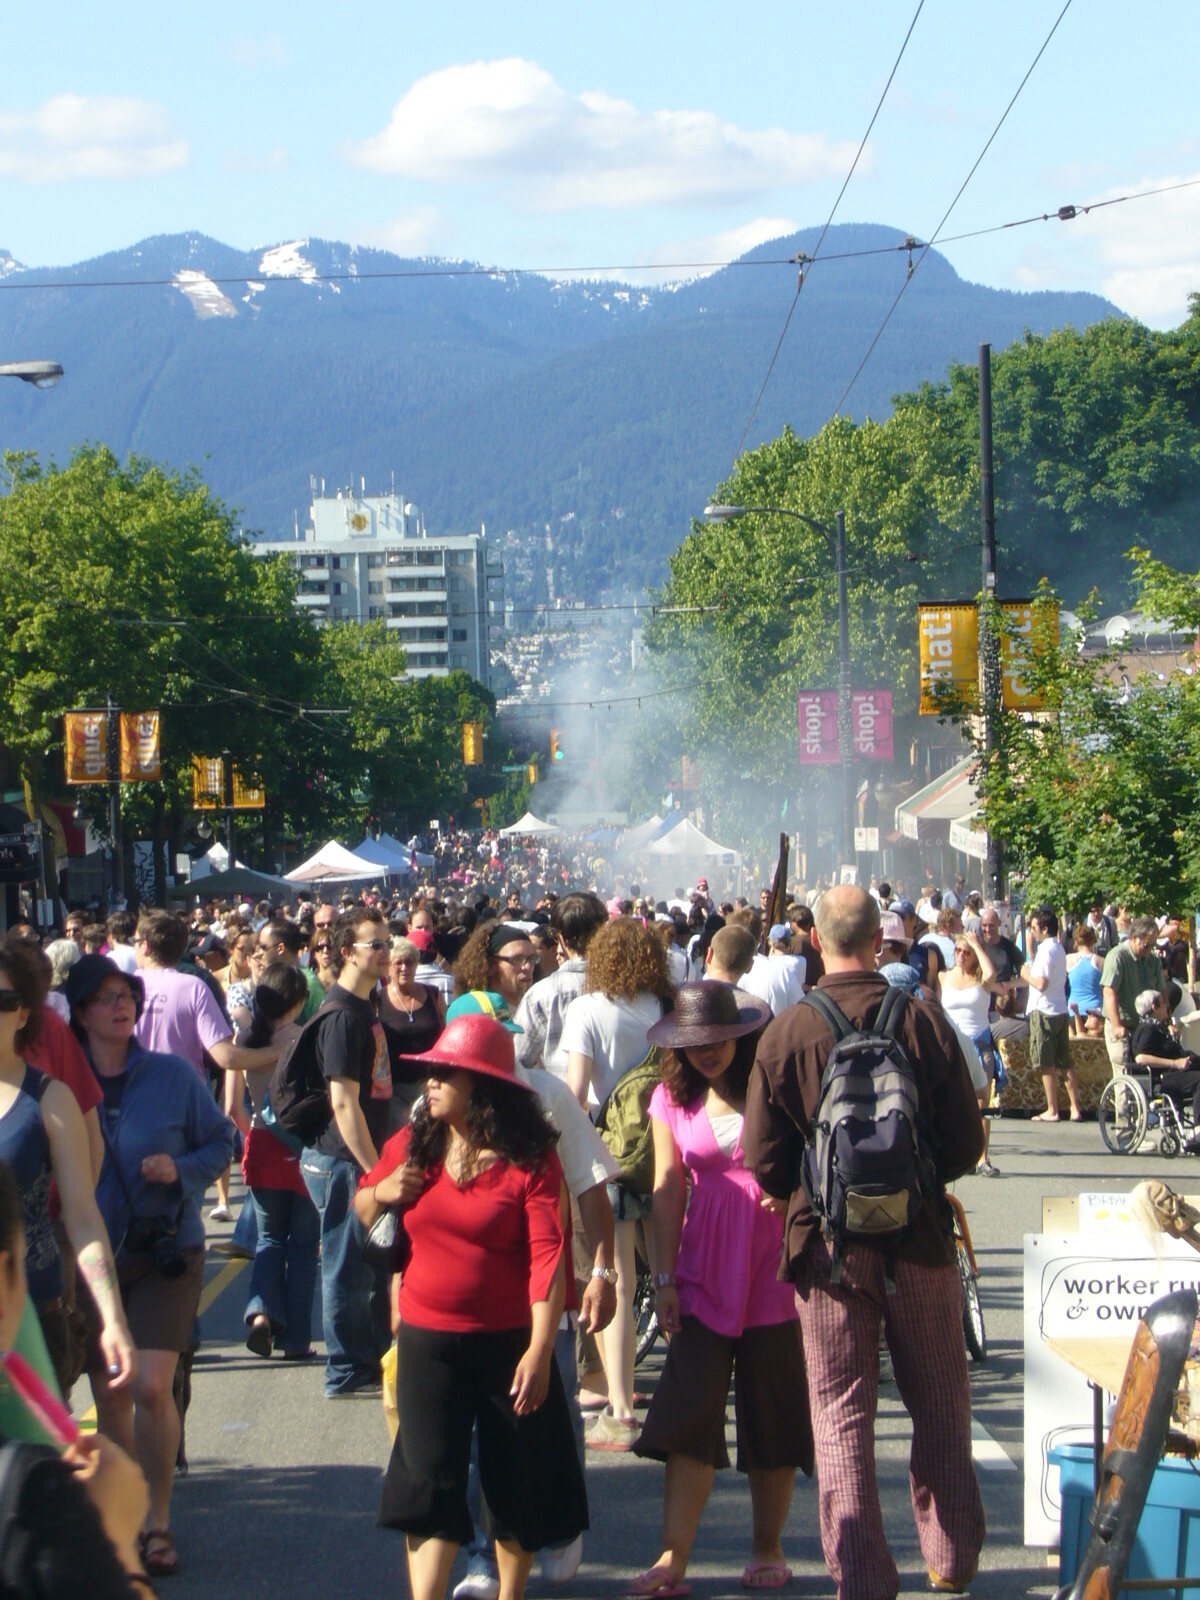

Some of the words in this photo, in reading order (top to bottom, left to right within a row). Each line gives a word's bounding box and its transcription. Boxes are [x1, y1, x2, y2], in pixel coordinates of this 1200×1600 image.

[800, 696, 827, 754] shop!
[853, 695, 880, 753] shop!
[1064, 1275, 1160, 1295] worker
[1168, 1280, 1200, 1295] ru
[1066, 1298, 1089, 1320] &
